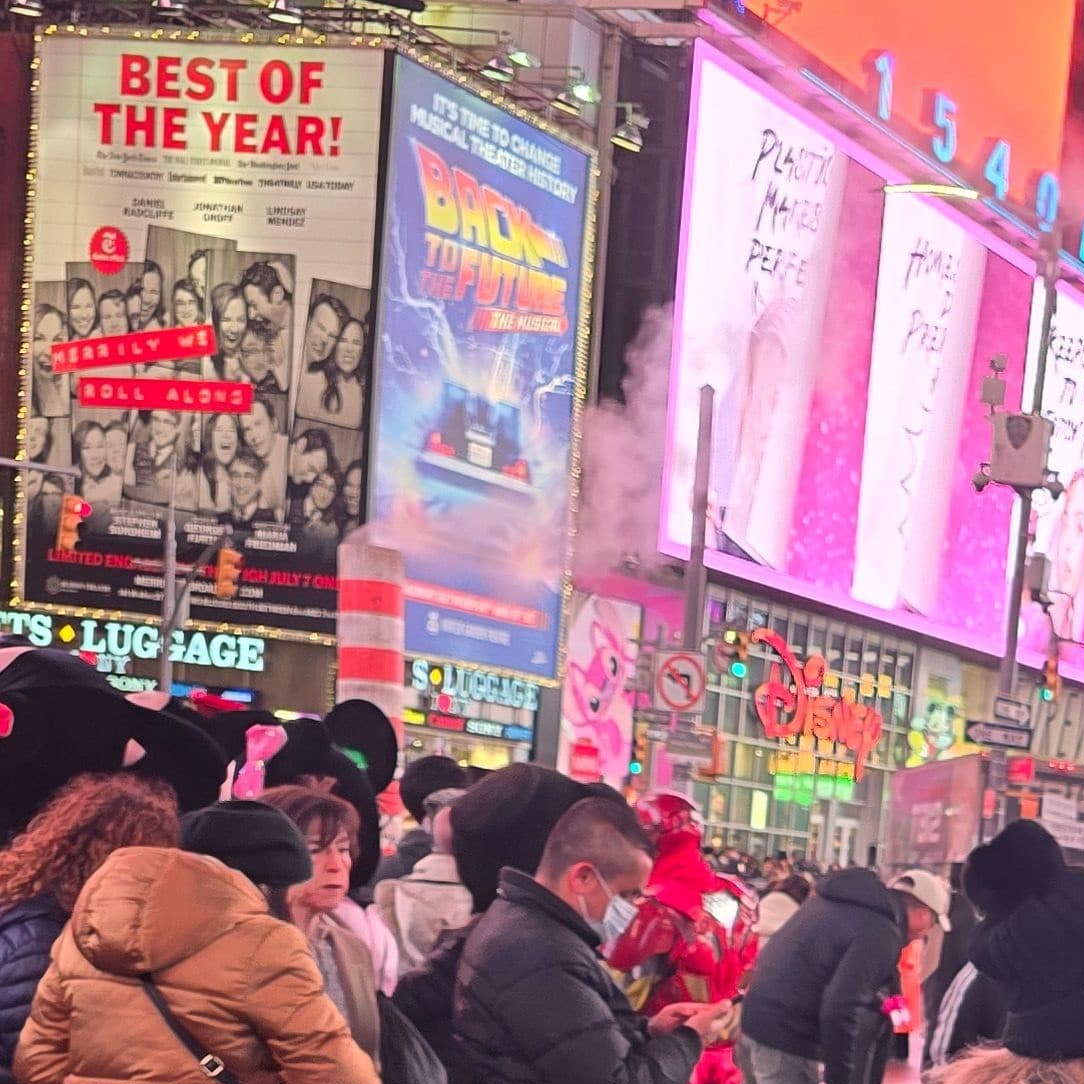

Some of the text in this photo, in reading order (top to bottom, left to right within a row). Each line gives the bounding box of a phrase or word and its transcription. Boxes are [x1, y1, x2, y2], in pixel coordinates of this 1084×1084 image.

[120, 53, 326, 105] BEST OF
[94, 103, 344, 157] THE YEAR!
[410, 104, 579, 204] MUSICAL THEATER HISTORY
[433, 93, 563, 175] IT'S TIME TO CHANGE
[425, 232, 456, 272] TO
[455, 248, 567, 315] FUTURE
[53, 330, 209, 364] MERRILY WE
[83, 384, 245, 406] ROLL ALONG
[48, 549, 103, 567] LIMITED
[80, 620, 265, 672] LUGGAGE
[441, 663, 540, 712] LUGGAGE
